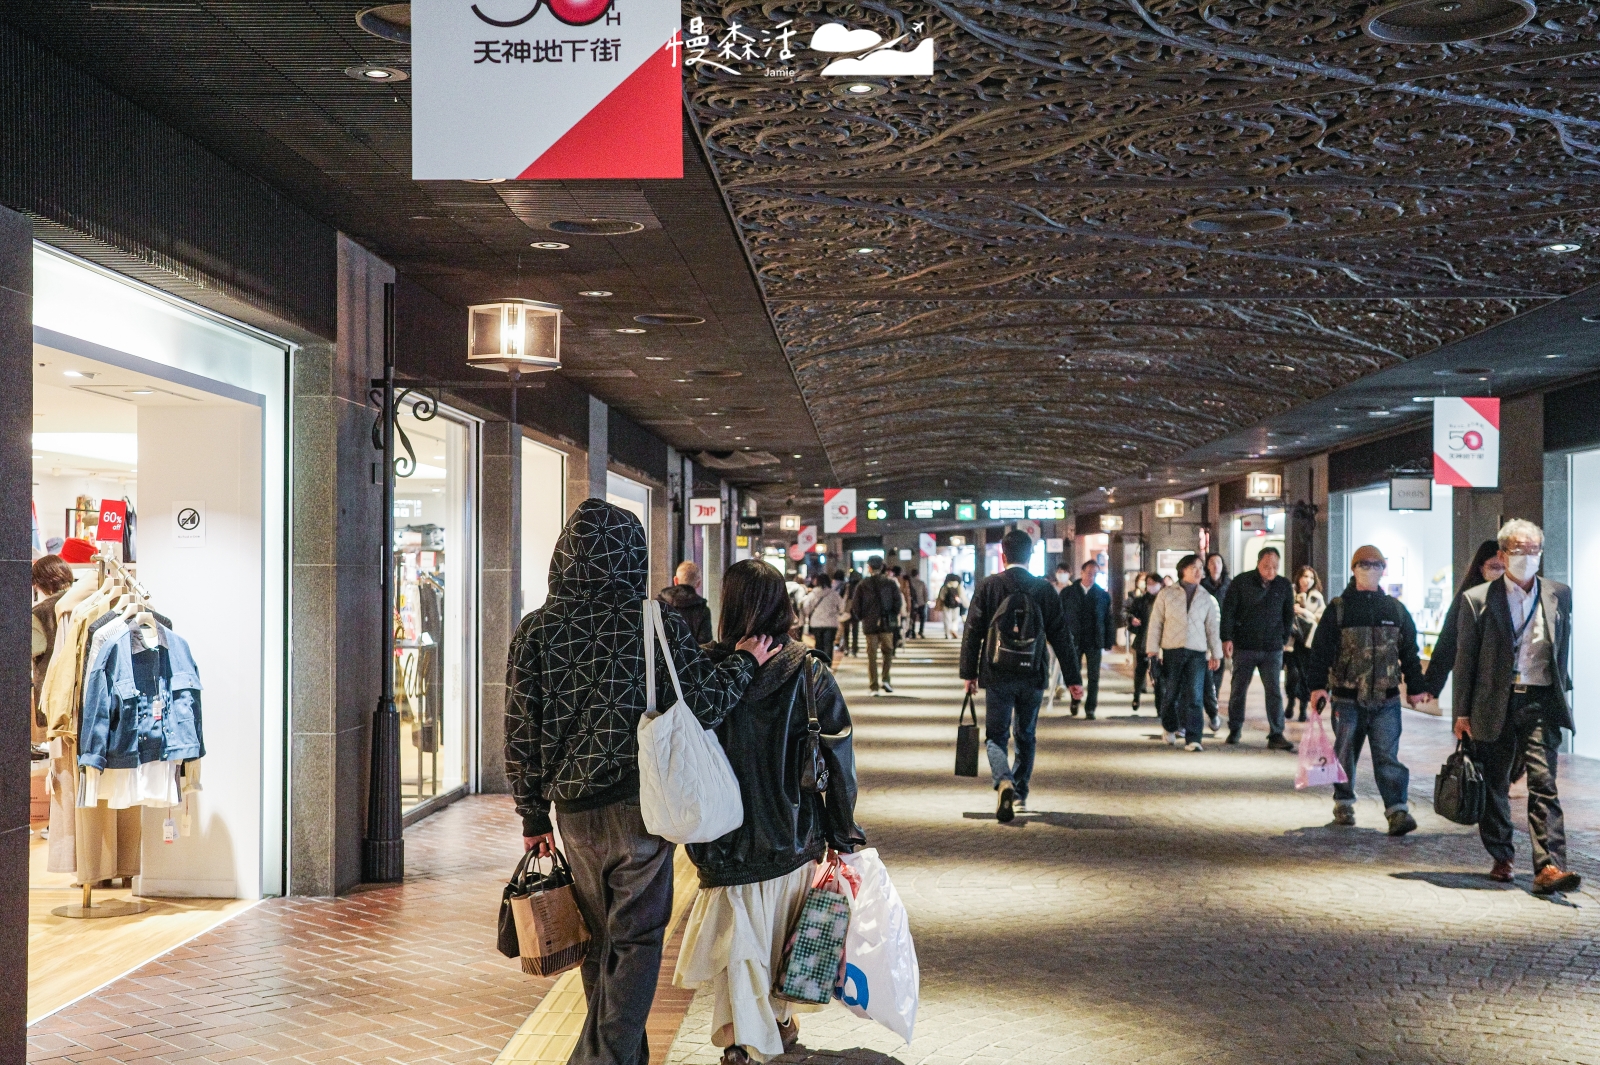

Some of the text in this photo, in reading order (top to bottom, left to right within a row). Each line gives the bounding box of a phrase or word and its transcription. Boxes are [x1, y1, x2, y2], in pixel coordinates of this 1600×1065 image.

[474, 38, 621, 64] 天神地下街
[103, 511, 122, 523] 60%
